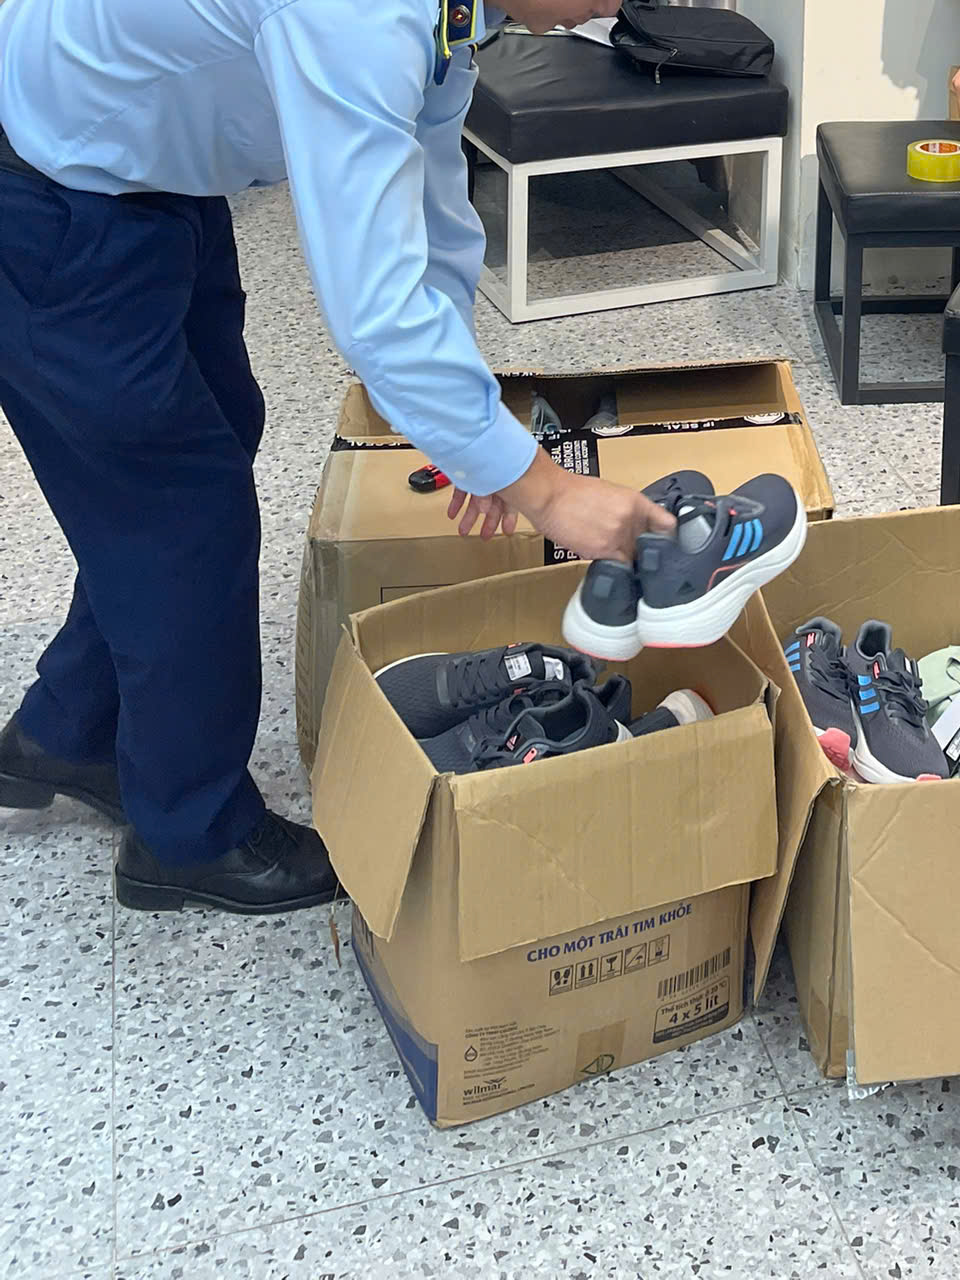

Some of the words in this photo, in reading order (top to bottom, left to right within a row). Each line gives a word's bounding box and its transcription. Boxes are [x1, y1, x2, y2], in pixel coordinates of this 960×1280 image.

[526, 945, 561, 963] CHO
[562, 934, 596, 955] MỘT
[598, 924, 629, 945] TRÁI
[632, 917, 655, 934] TIM
[659, 902, 693, 926] KHỎE
[669, 1012, 678, 1024] 4
[682, 1009, 691, 1021] x
[693, 1002, 702, 1016] 5
[464, 1083, 502, 1096] wilmar
